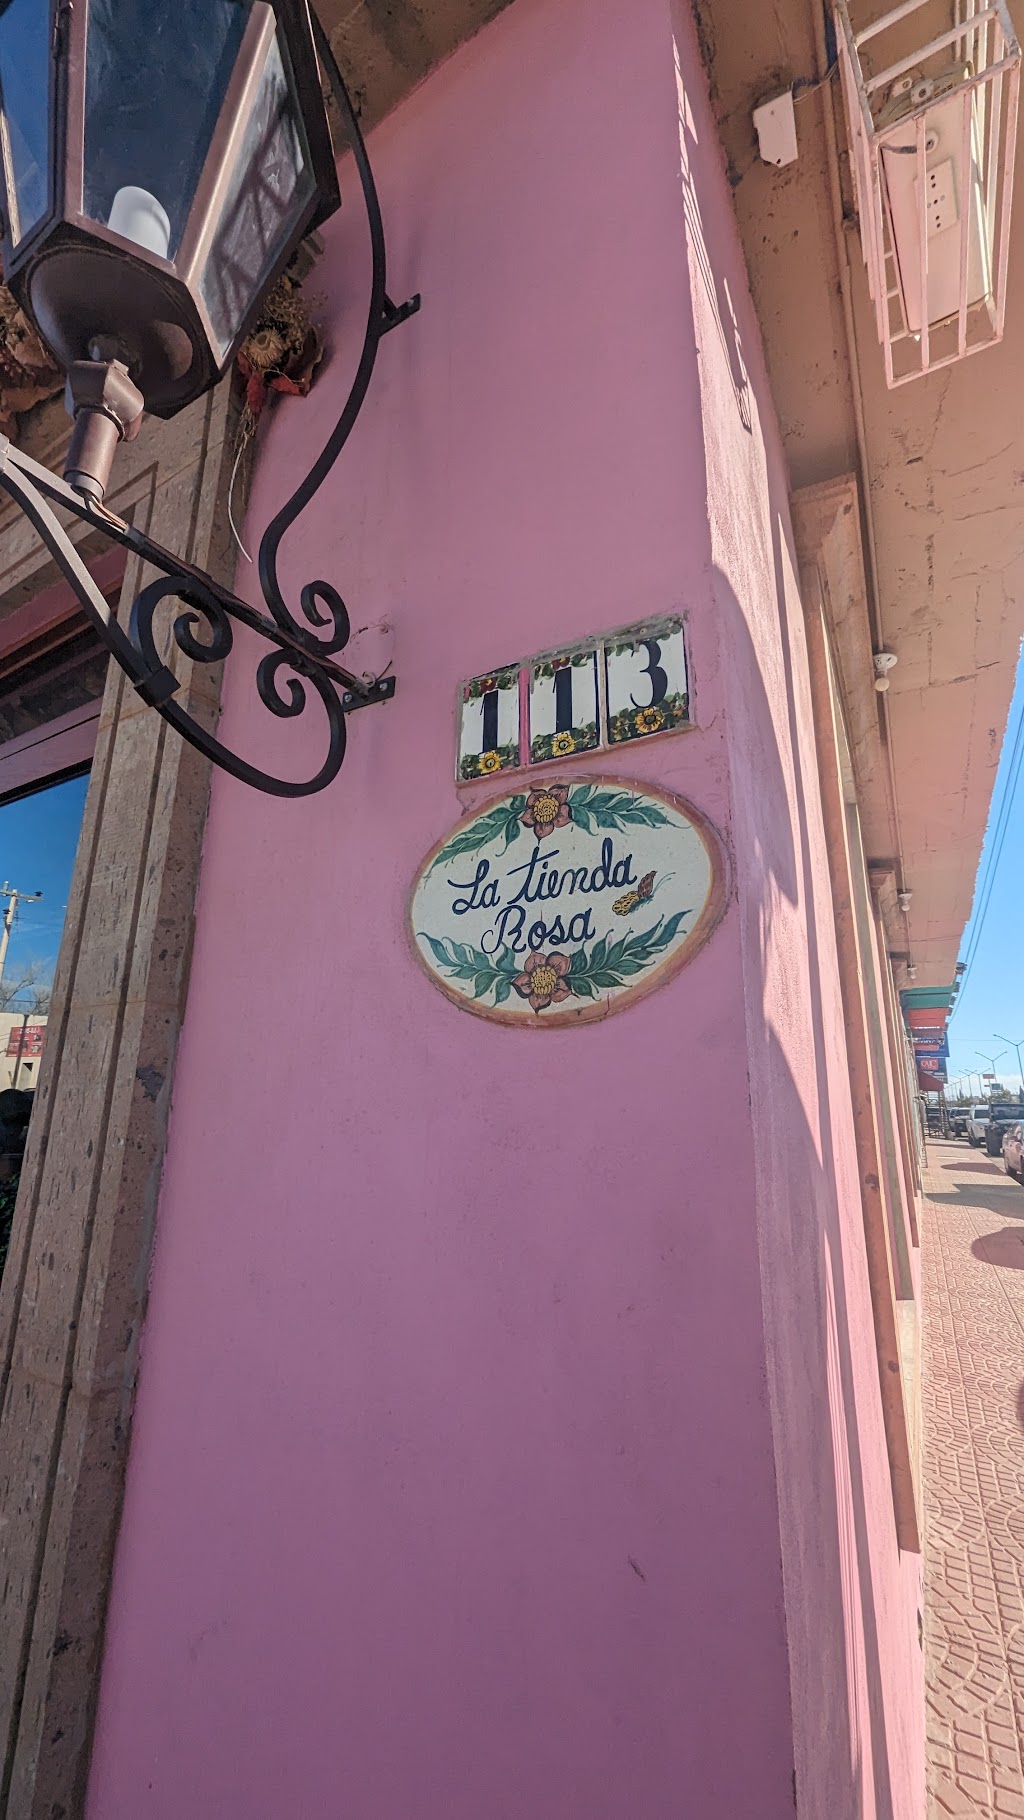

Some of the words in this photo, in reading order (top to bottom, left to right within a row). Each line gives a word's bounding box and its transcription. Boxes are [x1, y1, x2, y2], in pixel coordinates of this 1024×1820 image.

[480, 640, 669, 753] 113
[447, 858, 501, 916] La
[506, 837, 638, 905] tienda
[480, 904, 596, 955] Rosa
